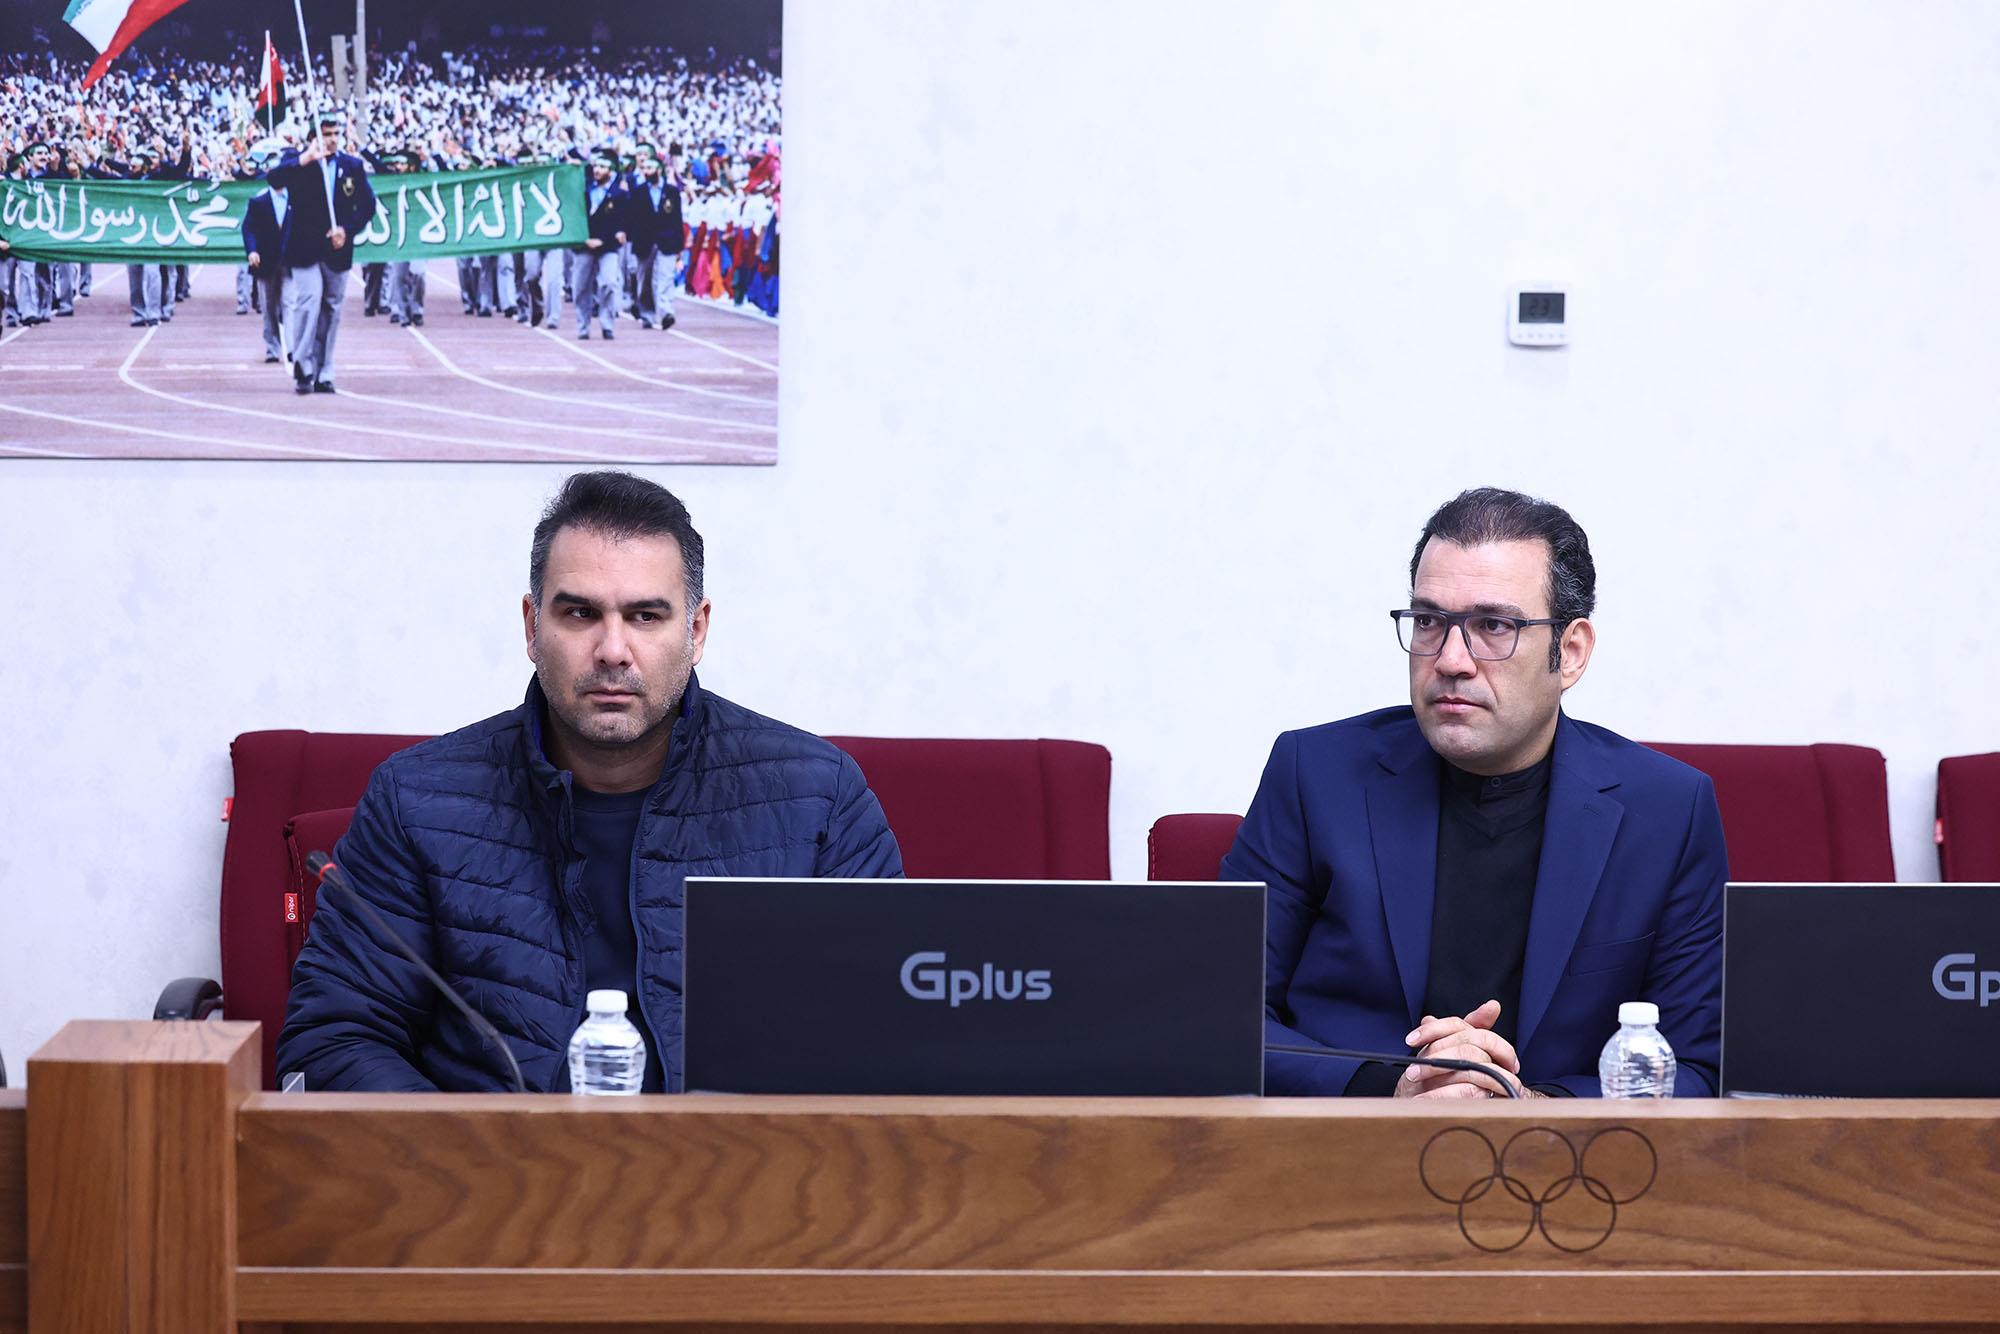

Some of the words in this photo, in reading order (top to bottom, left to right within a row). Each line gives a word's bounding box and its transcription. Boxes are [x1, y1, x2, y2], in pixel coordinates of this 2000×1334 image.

[48, 186, 148, 244] رسول
[529, 171, 564, 236] لا
[900, 951, 1053, 1008] Gplus
